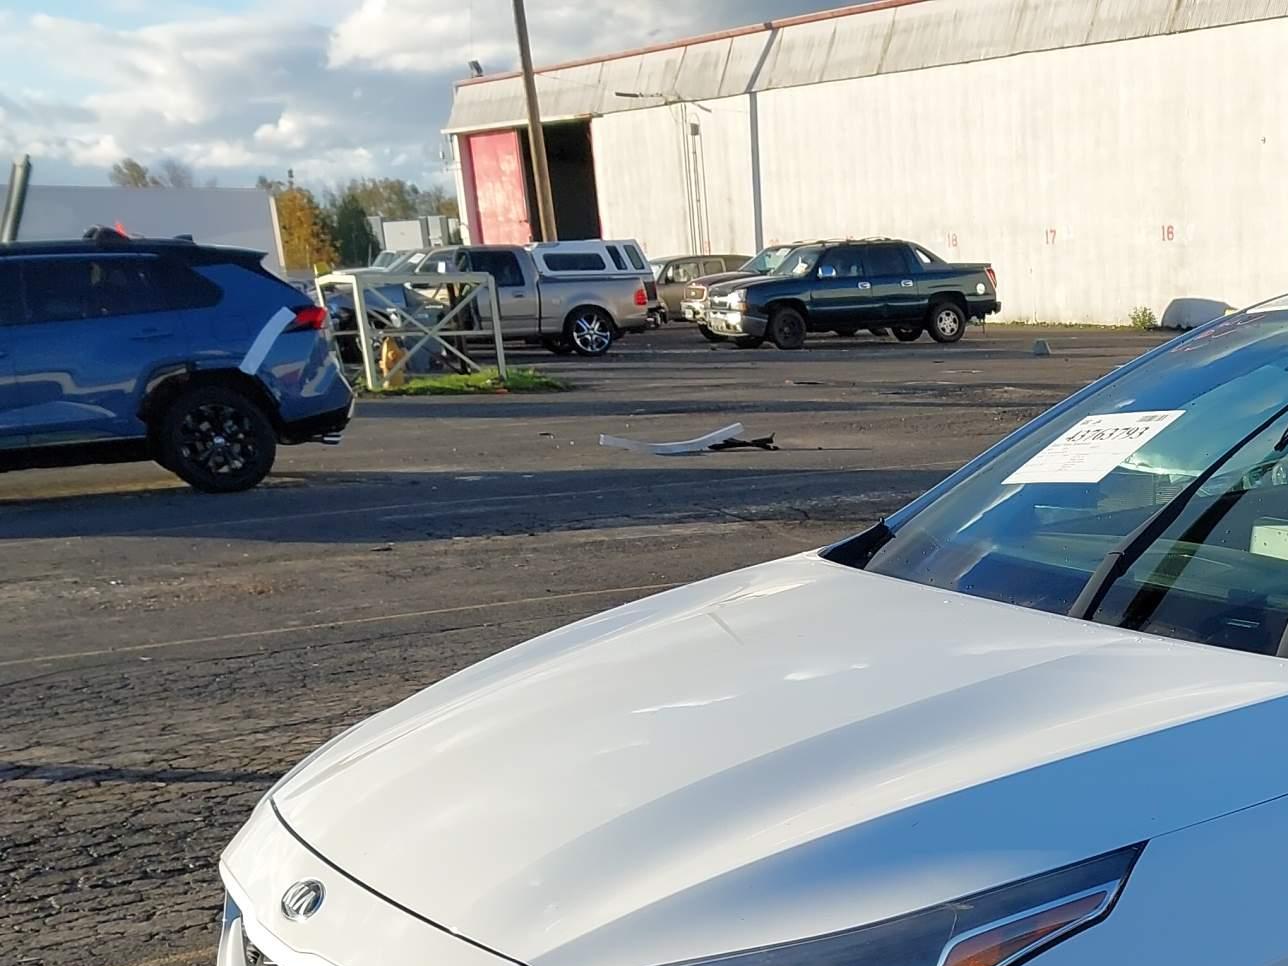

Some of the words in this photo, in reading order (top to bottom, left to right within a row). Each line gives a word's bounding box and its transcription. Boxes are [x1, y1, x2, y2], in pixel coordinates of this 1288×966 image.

[946, 233, 958, 248] 18
[1045, 229, 1057, 245] 17
[1161, 225, 1175, 241] 16
[1066, 426, 1150, 442] 43763793
